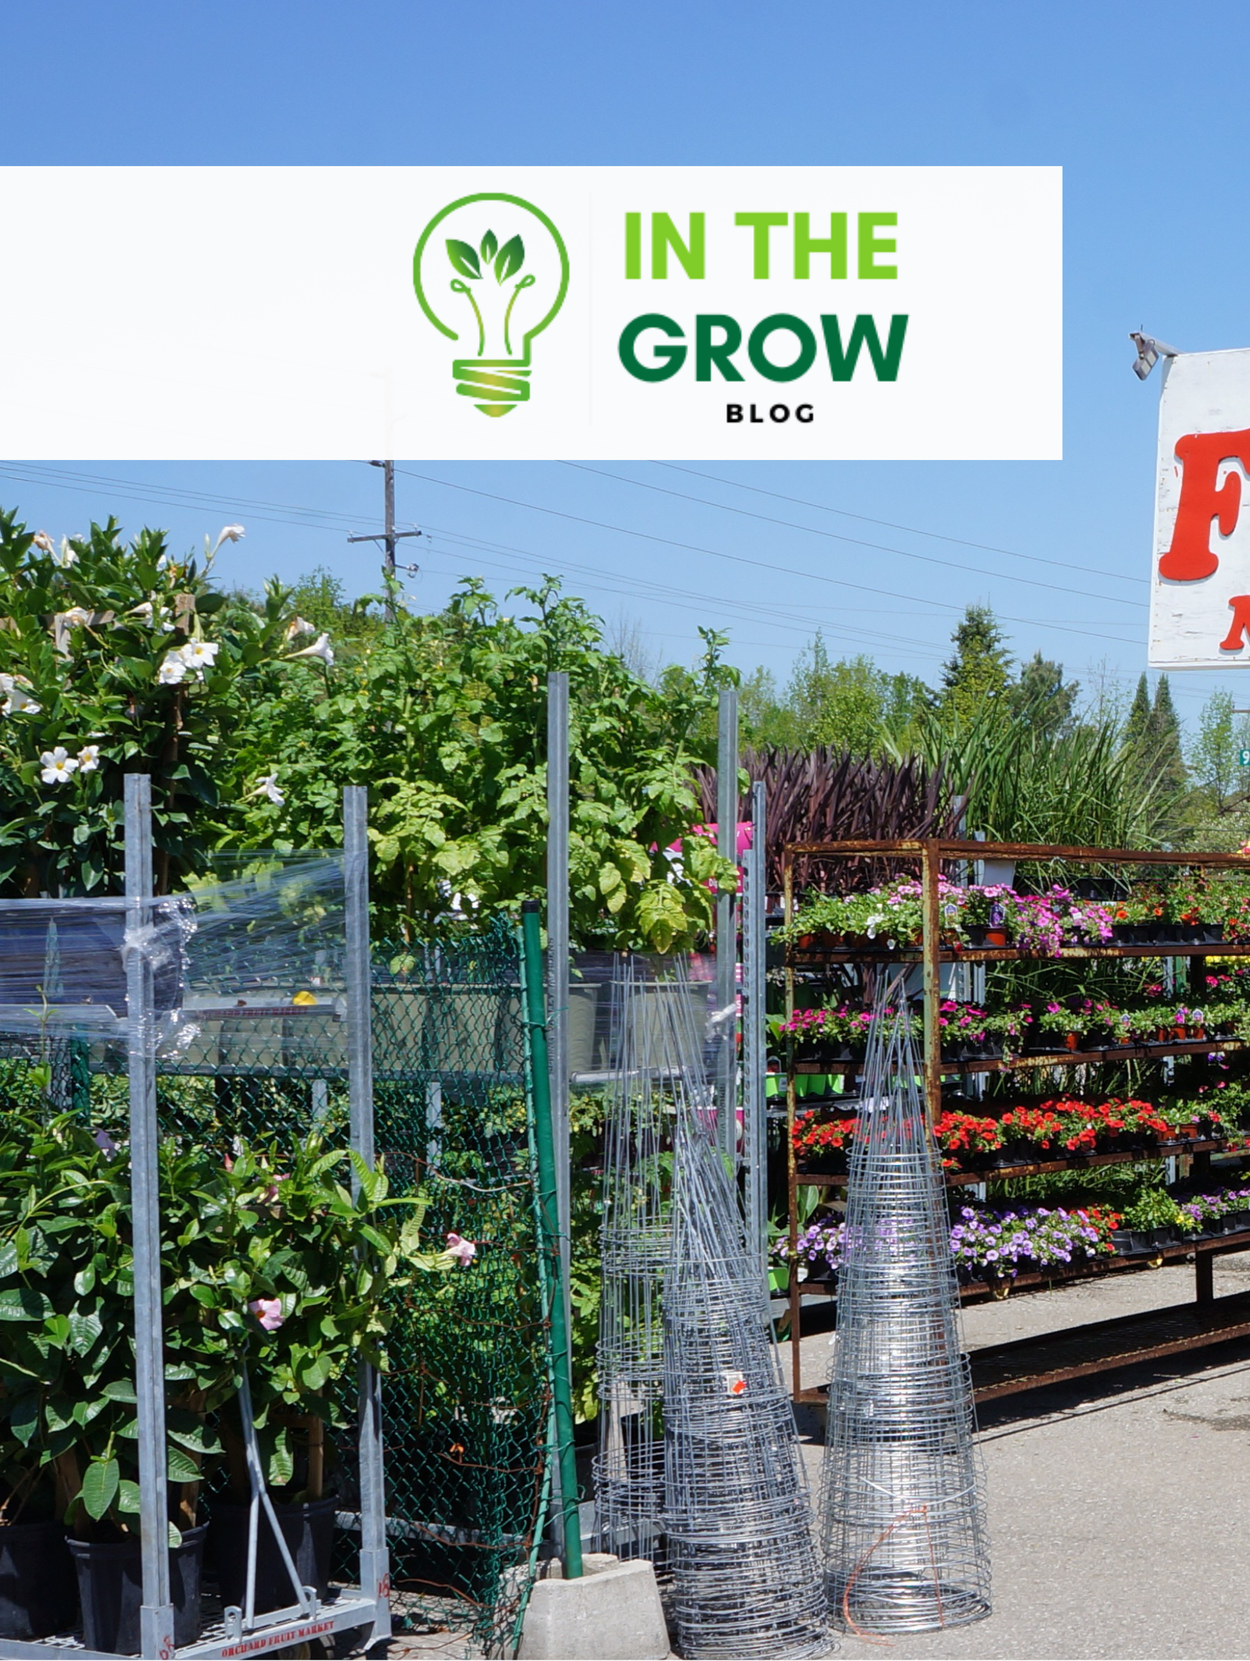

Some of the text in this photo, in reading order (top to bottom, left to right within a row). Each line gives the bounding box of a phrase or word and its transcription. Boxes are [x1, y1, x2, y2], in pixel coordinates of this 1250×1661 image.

[221, 1620, 335, 1658] ORCHARD FRUIT MARKET
